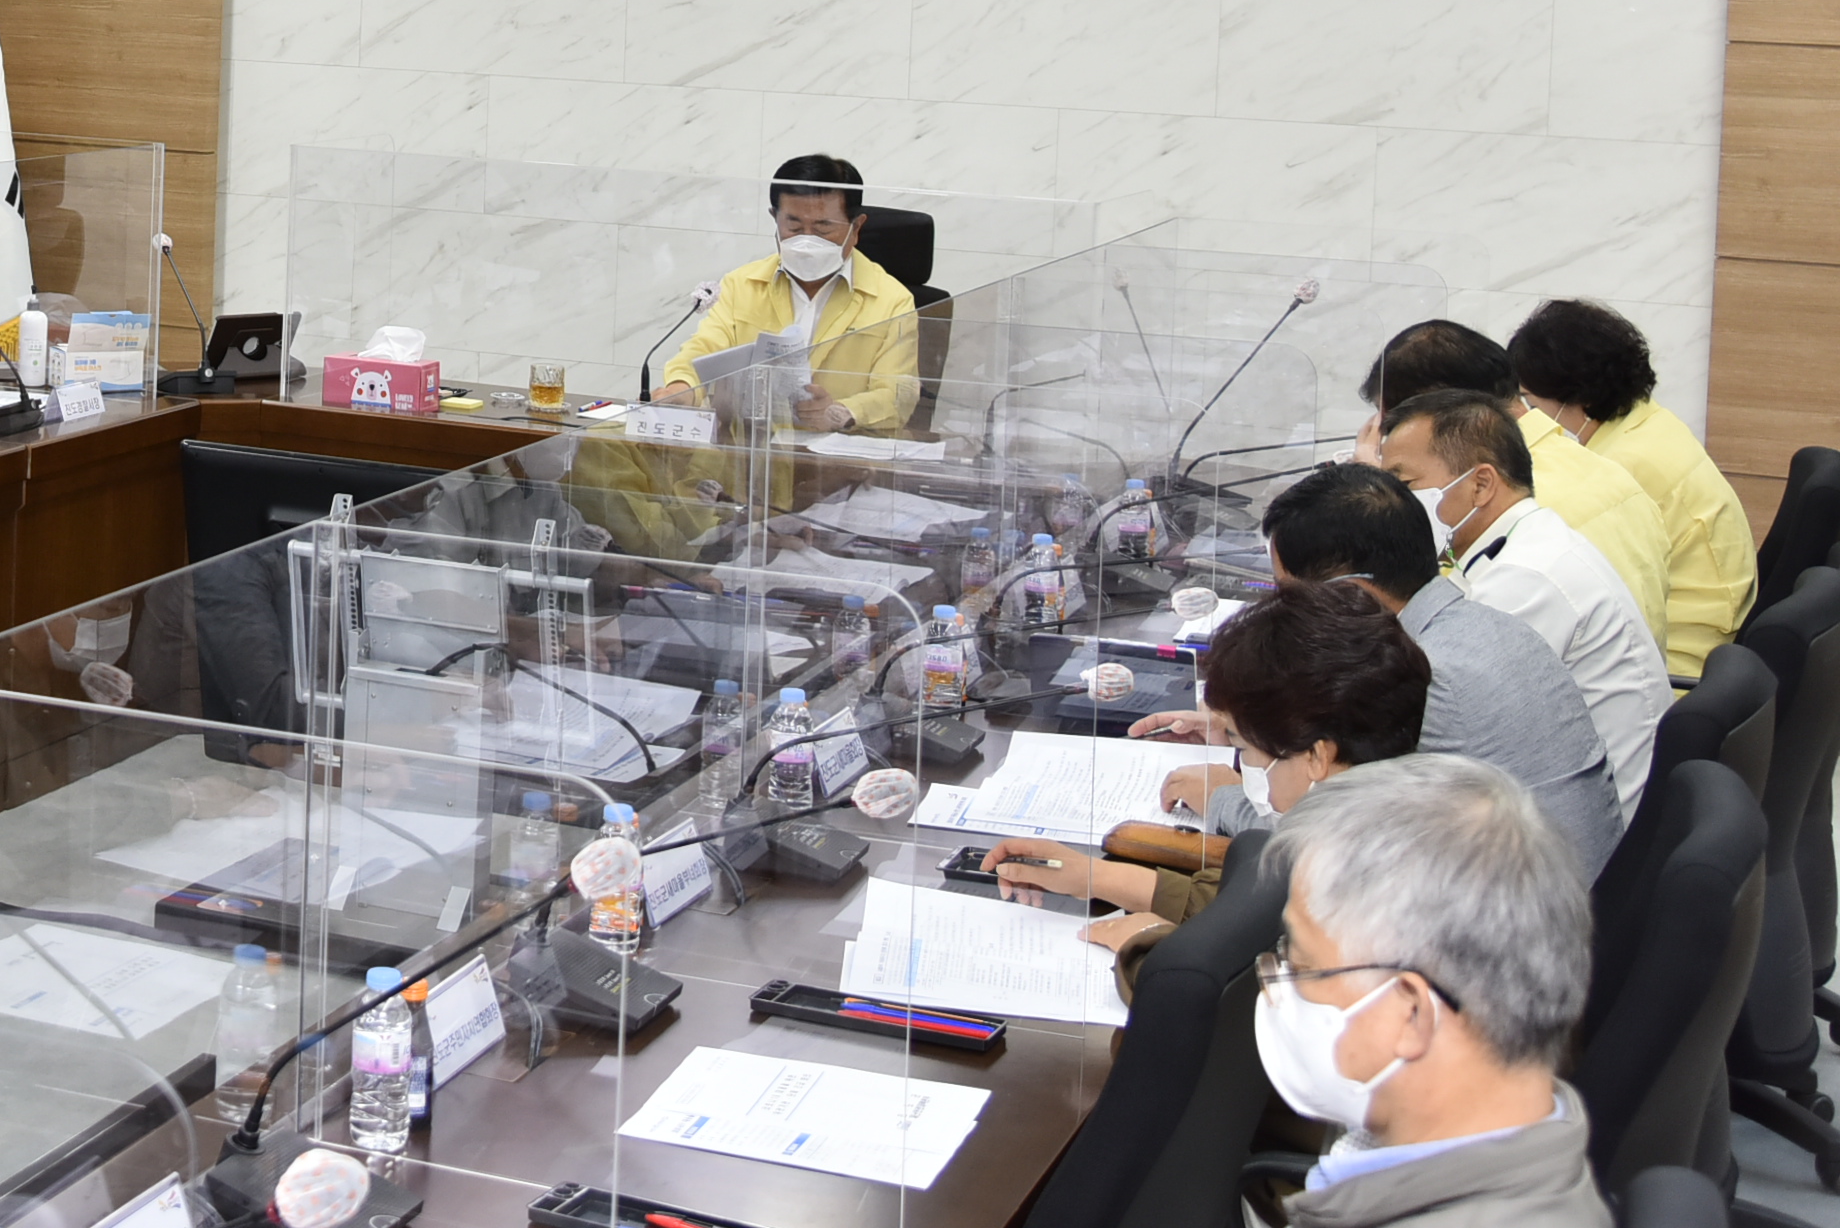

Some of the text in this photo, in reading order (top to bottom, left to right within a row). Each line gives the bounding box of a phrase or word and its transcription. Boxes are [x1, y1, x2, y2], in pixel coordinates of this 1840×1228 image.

[65, 397, 100, 416] 진도경찰서장
[820, 735, 864, 783] 진도군새마을회장
[648, 857, 708, 910] 진도군새마을부녀회장
